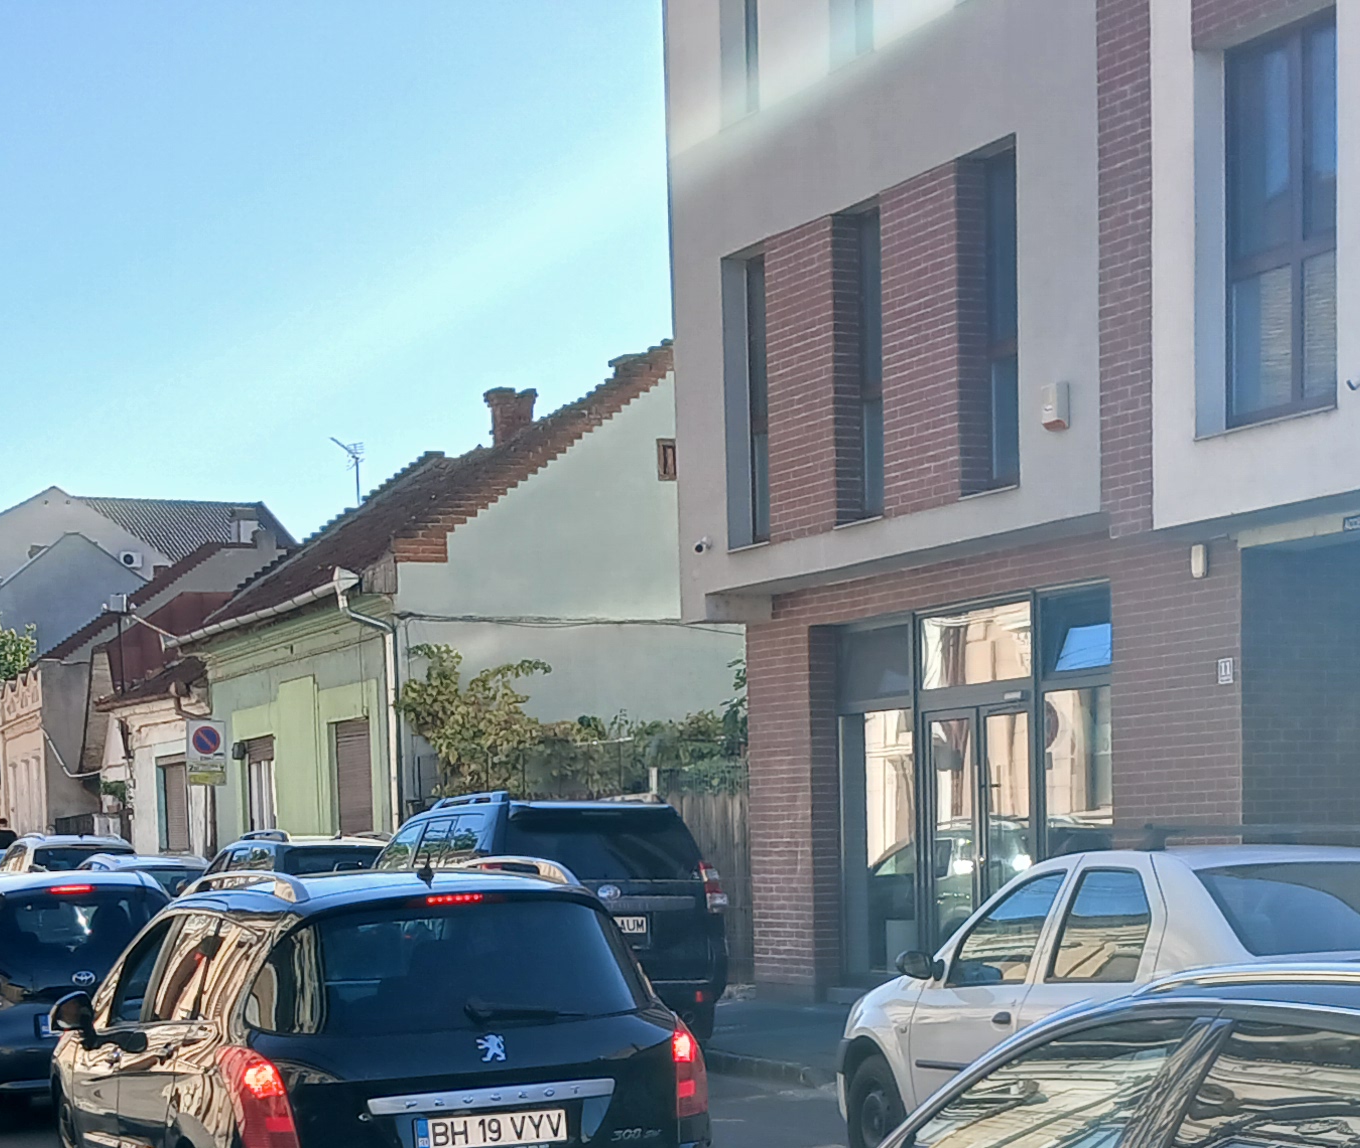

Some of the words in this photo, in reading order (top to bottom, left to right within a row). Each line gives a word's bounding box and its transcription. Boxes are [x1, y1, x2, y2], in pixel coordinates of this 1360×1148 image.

[431, 1120, 469, 1147] BH
[478, 1118, 502, 1143] 19
[509, 1112, 562, 1140] VYV
